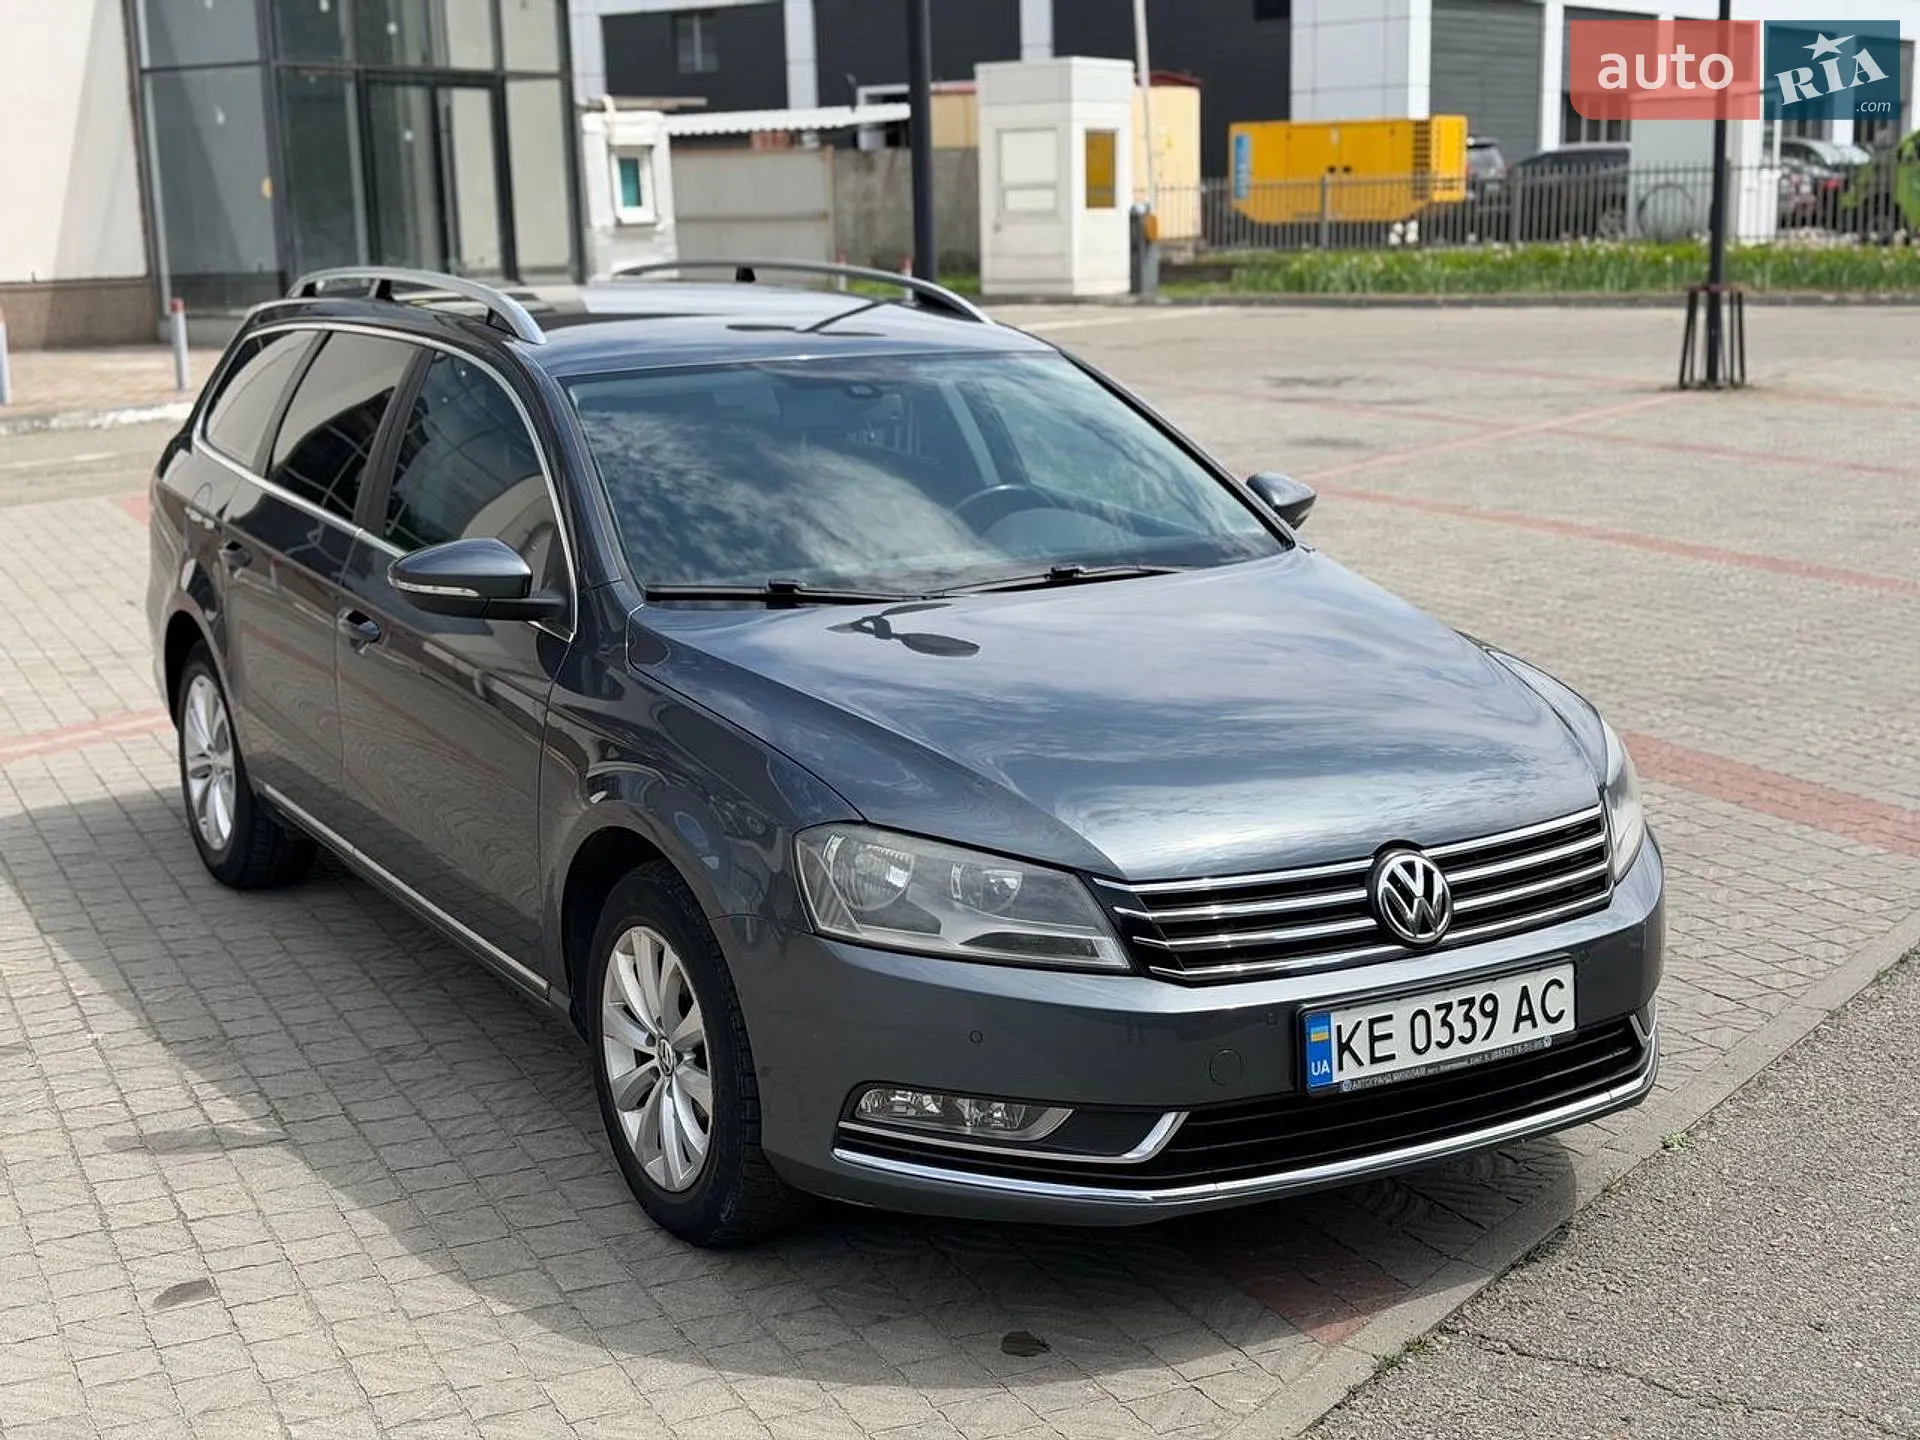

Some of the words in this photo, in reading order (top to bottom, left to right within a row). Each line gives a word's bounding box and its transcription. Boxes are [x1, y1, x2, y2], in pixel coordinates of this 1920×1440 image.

[1336, 1013, 1397, 1072] KE
[1410, 993, 1499, 1055] 0339
[1513, 978, 1565, 1033] AC
[1311, 1059, 1331, 1076] UA
